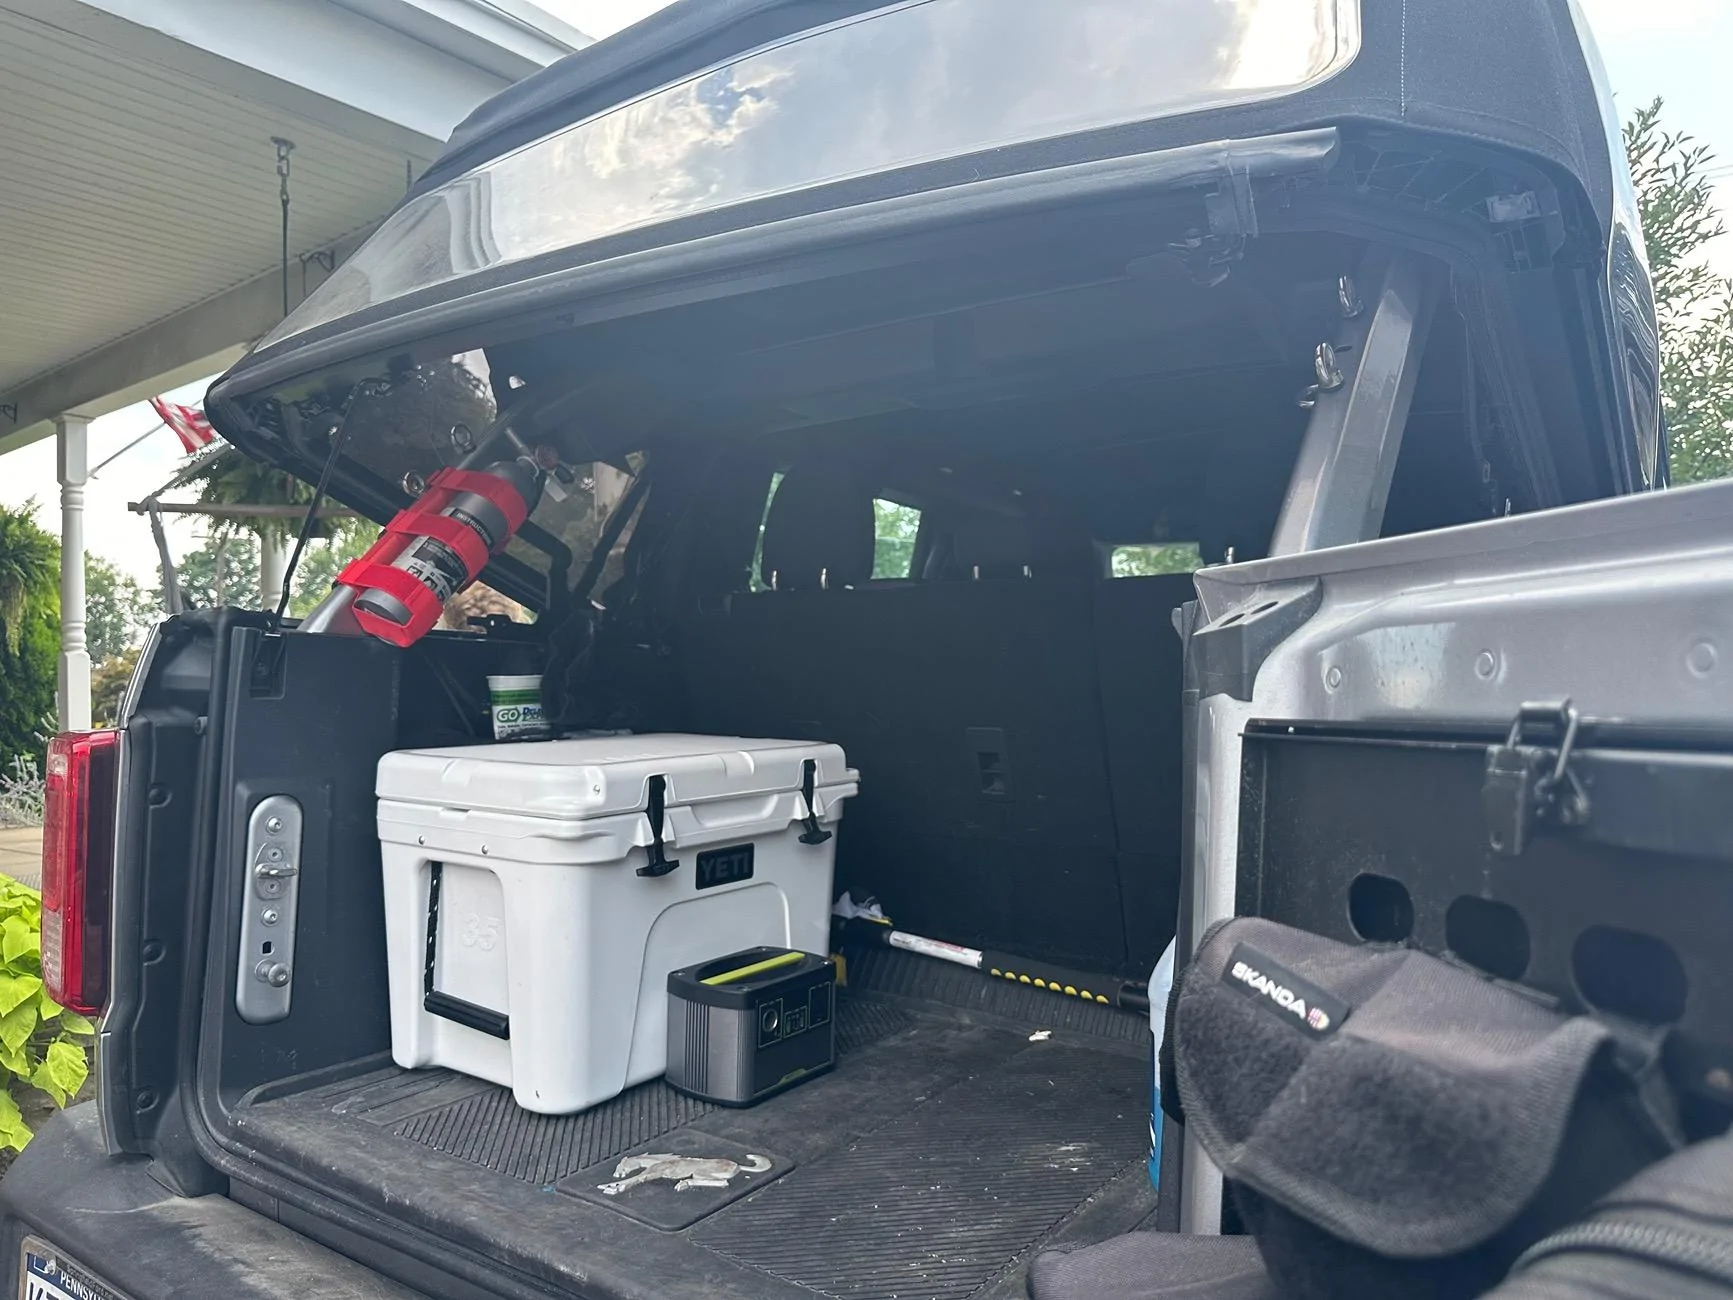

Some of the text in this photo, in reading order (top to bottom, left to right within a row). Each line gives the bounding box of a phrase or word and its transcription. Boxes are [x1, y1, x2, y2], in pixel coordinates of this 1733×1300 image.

[498, 709, 519, 721] GO
[700, 852, 750, 882] YETI
[1231, 961, 1306, 1019] SKANDA
